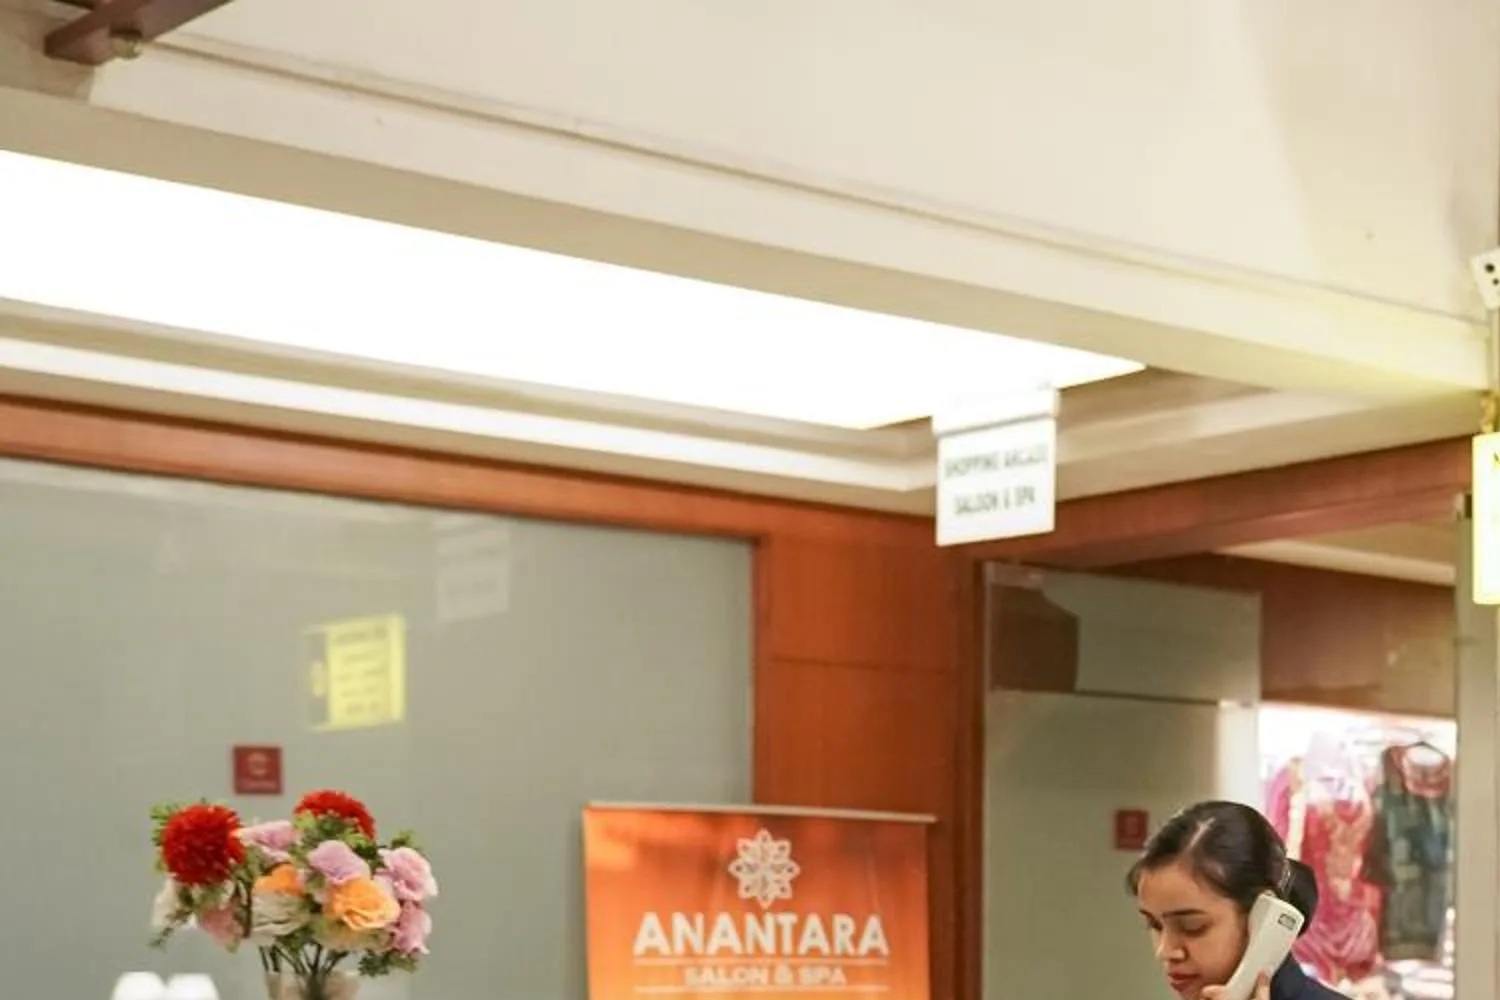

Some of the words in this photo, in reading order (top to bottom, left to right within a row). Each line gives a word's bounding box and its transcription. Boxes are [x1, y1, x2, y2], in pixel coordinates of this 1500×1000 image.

[633, 911, 890, 956] ANANTARA
[684, 966, 769, 986] SALON
[774, 963, 794, 986] &
[799, 965, 847, 986] SPA
